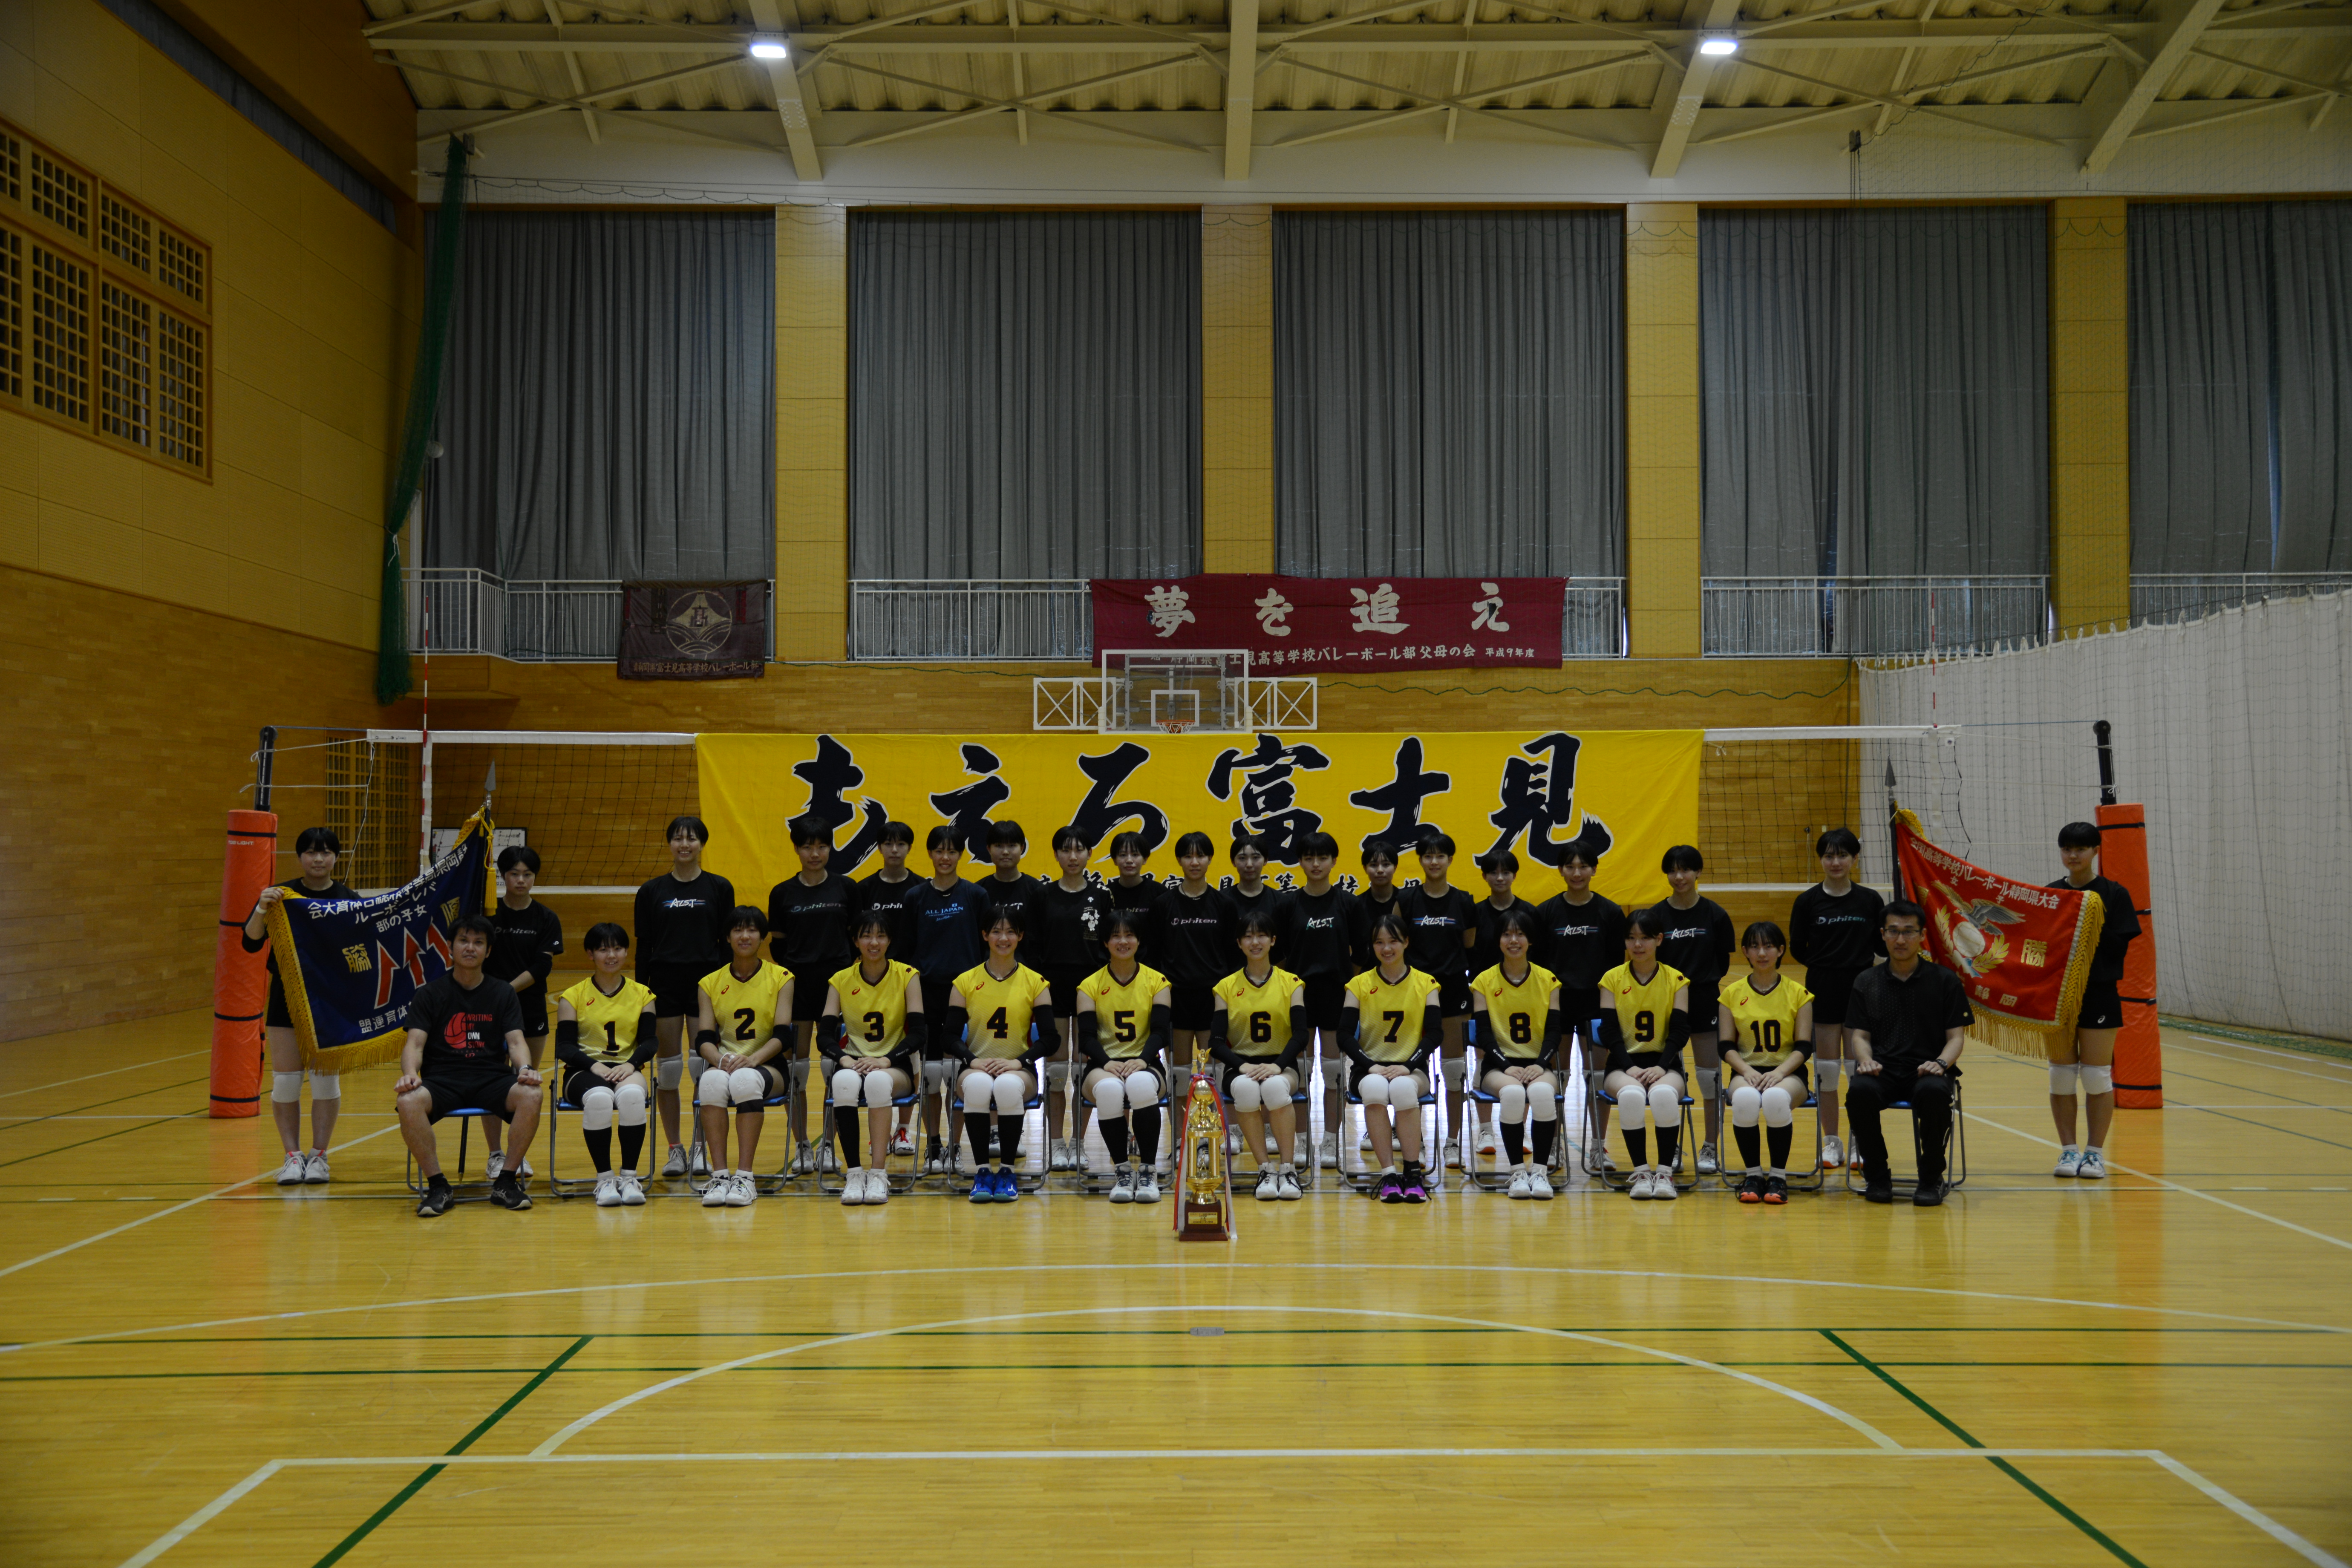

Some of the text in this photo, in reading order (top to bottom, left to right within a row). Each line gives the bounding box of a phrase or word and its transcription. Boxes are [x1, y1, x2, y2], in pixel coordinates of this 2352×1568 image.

[1144, 582, 1510, 637] 夢を追え
[803, 902, 841, 911] phiten
[941, 906, 963, 914] JAPAN
[1827, 915, 1866, 925] phiten
[503, 927, 537, 935] phiten
[359, 1001, 412, 1034] 体育連盟
[466, 1013, 493, 1022] WRITING
[734, 1008, 756, 1041] 2
[863, 1011, 885, 1042] 3
[986, 1006, 1008, 1039] 4
[1114, 1010, 1136, 1043] 5
[1249, 1011, 1271, 1043] 6
[1383, 1011, 1404, 1043] 7
[1509, 1012, 1531, 1044] 8
[1635, 1010, 1654, 1042] 9
[467, 1032, 480, 1040] OWN
[604, 1021, 620, 1051] 1
[1750, 1020, 1781, 1052] 10
